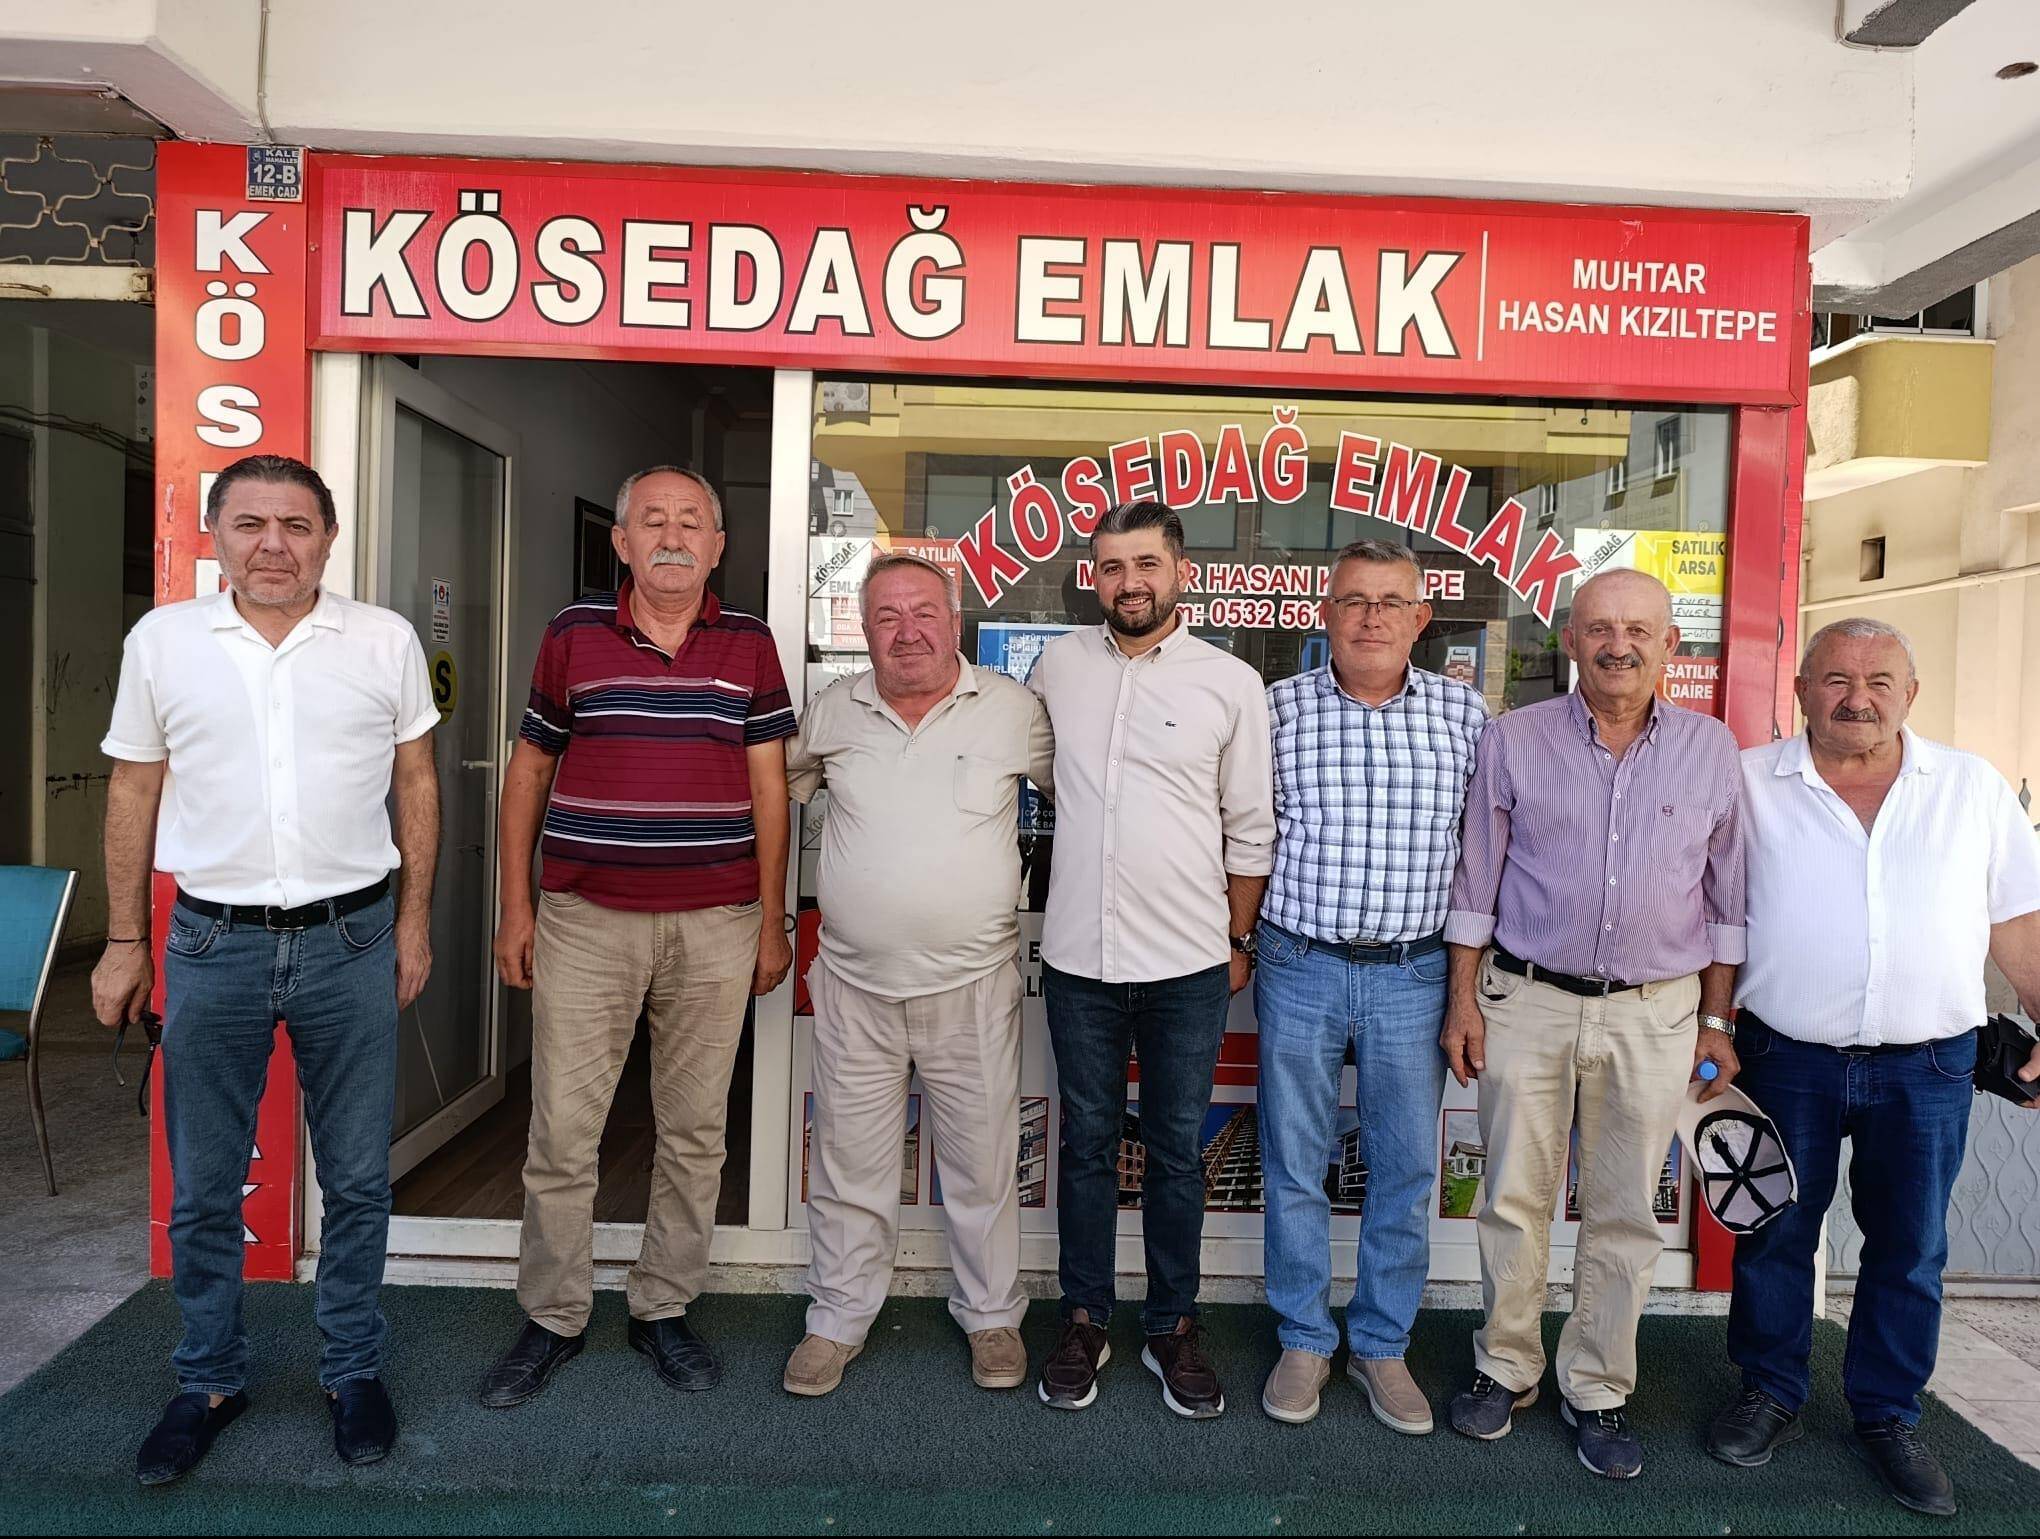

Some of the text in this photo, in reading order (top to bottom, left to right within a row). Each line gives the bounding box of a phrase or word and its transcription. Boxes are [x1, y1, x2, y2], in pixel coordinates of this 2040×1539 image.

[265, 149, 299, 157] KALE
[253, 164, 296, 184] 12-B
[249, 185, 275, 197] EMEK
[340, 188, 1466, 359] KÖSEDAĞ EMLAK
[1572, 258, 1706, 294] MUHTAR
[1498, 300, 1777, 342] HASAN KIZILTEPE
[954, 405, 1584, 629] KÖSEDAĞ EMLAK
[1671, 540, 1725, 556] SATILIK
[813, 541, 858, 585] KÖSEDAĞ
[1677, 560, 1717, 576] ARSA
[1207, 564, 1312, 596] HASAN
[1210, 598, 1275, 628] 0532
[1665, 663, 1719, 680] SATILIK
[1671, 680, 1713, 699] DAİRE
